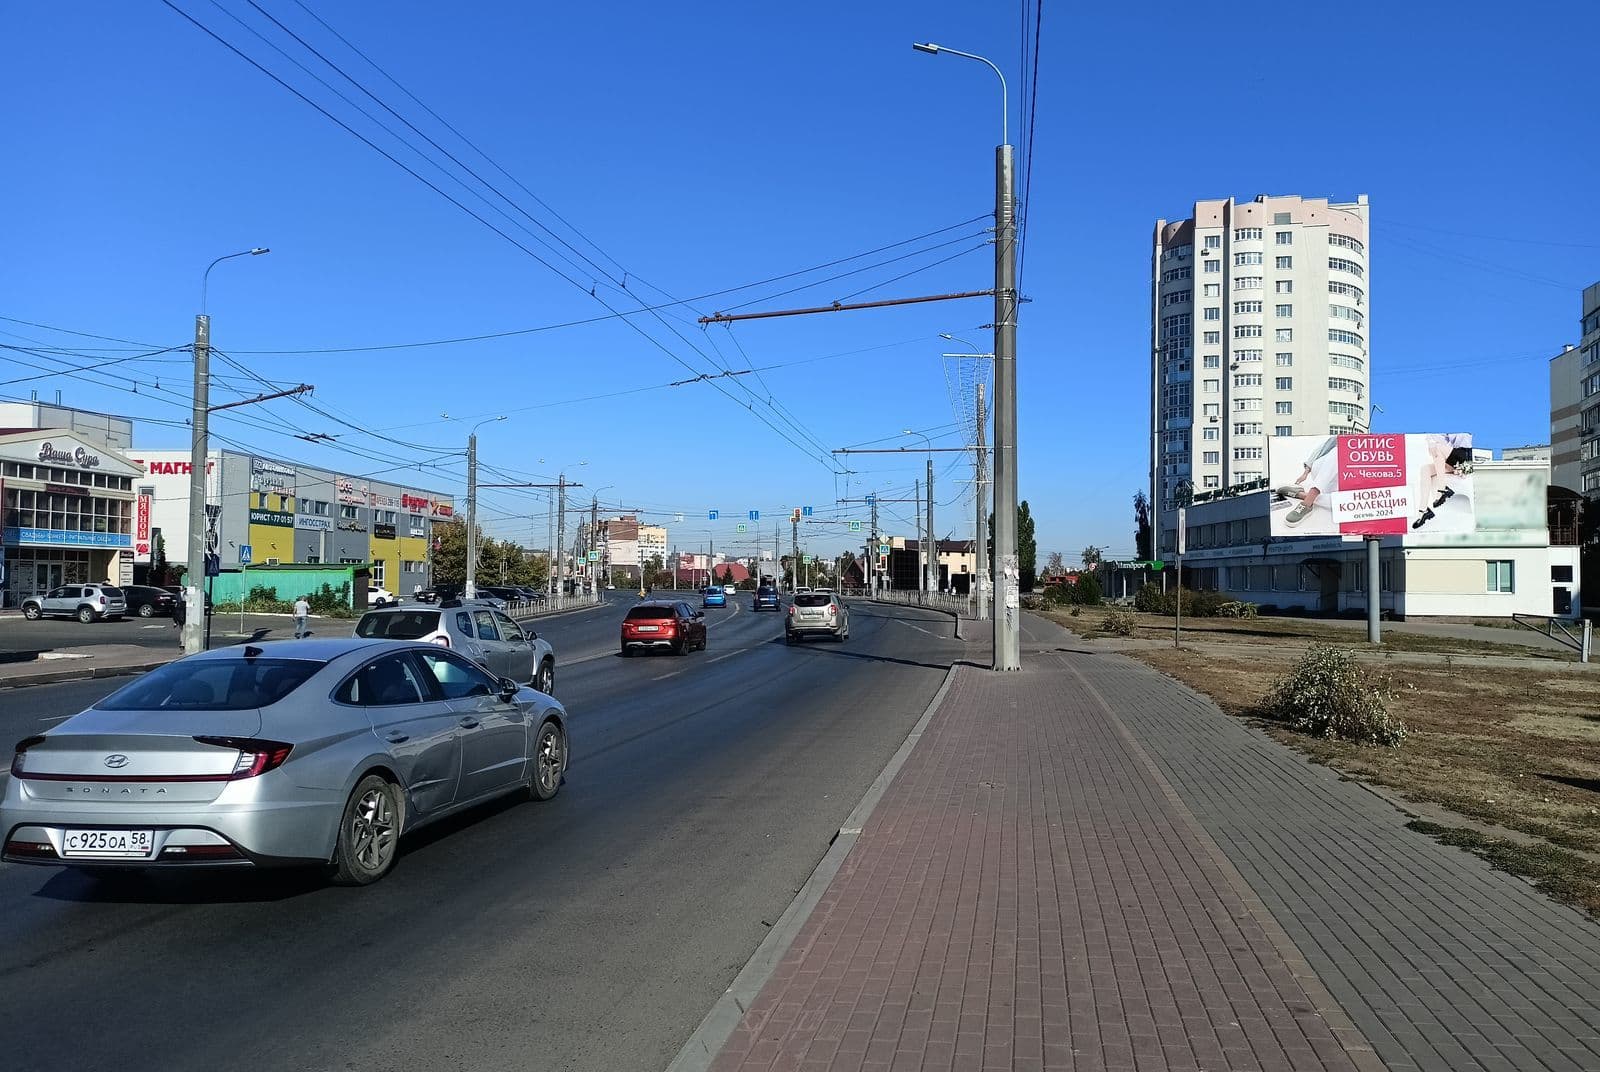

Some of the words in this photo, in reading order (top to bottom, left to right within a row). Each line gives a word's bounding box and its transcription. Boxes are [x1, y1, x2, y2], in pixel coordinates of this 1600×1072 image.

[1347, 438, 1396, 450] СИТИС
[39, 442, 73, 462] Ваша
[75, 446, 100, 469] Сура
[1349, 451, 1394, 462] ОБУВЬ
[150, 461, 215, 475] МАГНТ
[1343, 472, 1356, 480] ул.
[1353, 490, 1392, 501] НОВАЯ
[1339, 498, 1407, 512] КОЛЛЕКЦИЯ
[138, 496, 148, 539] МЯСНОЙ
[251, 512, 270, 521] ЮРИСТ
[298, 517, 331, 529] ИНГОССТРАХ
